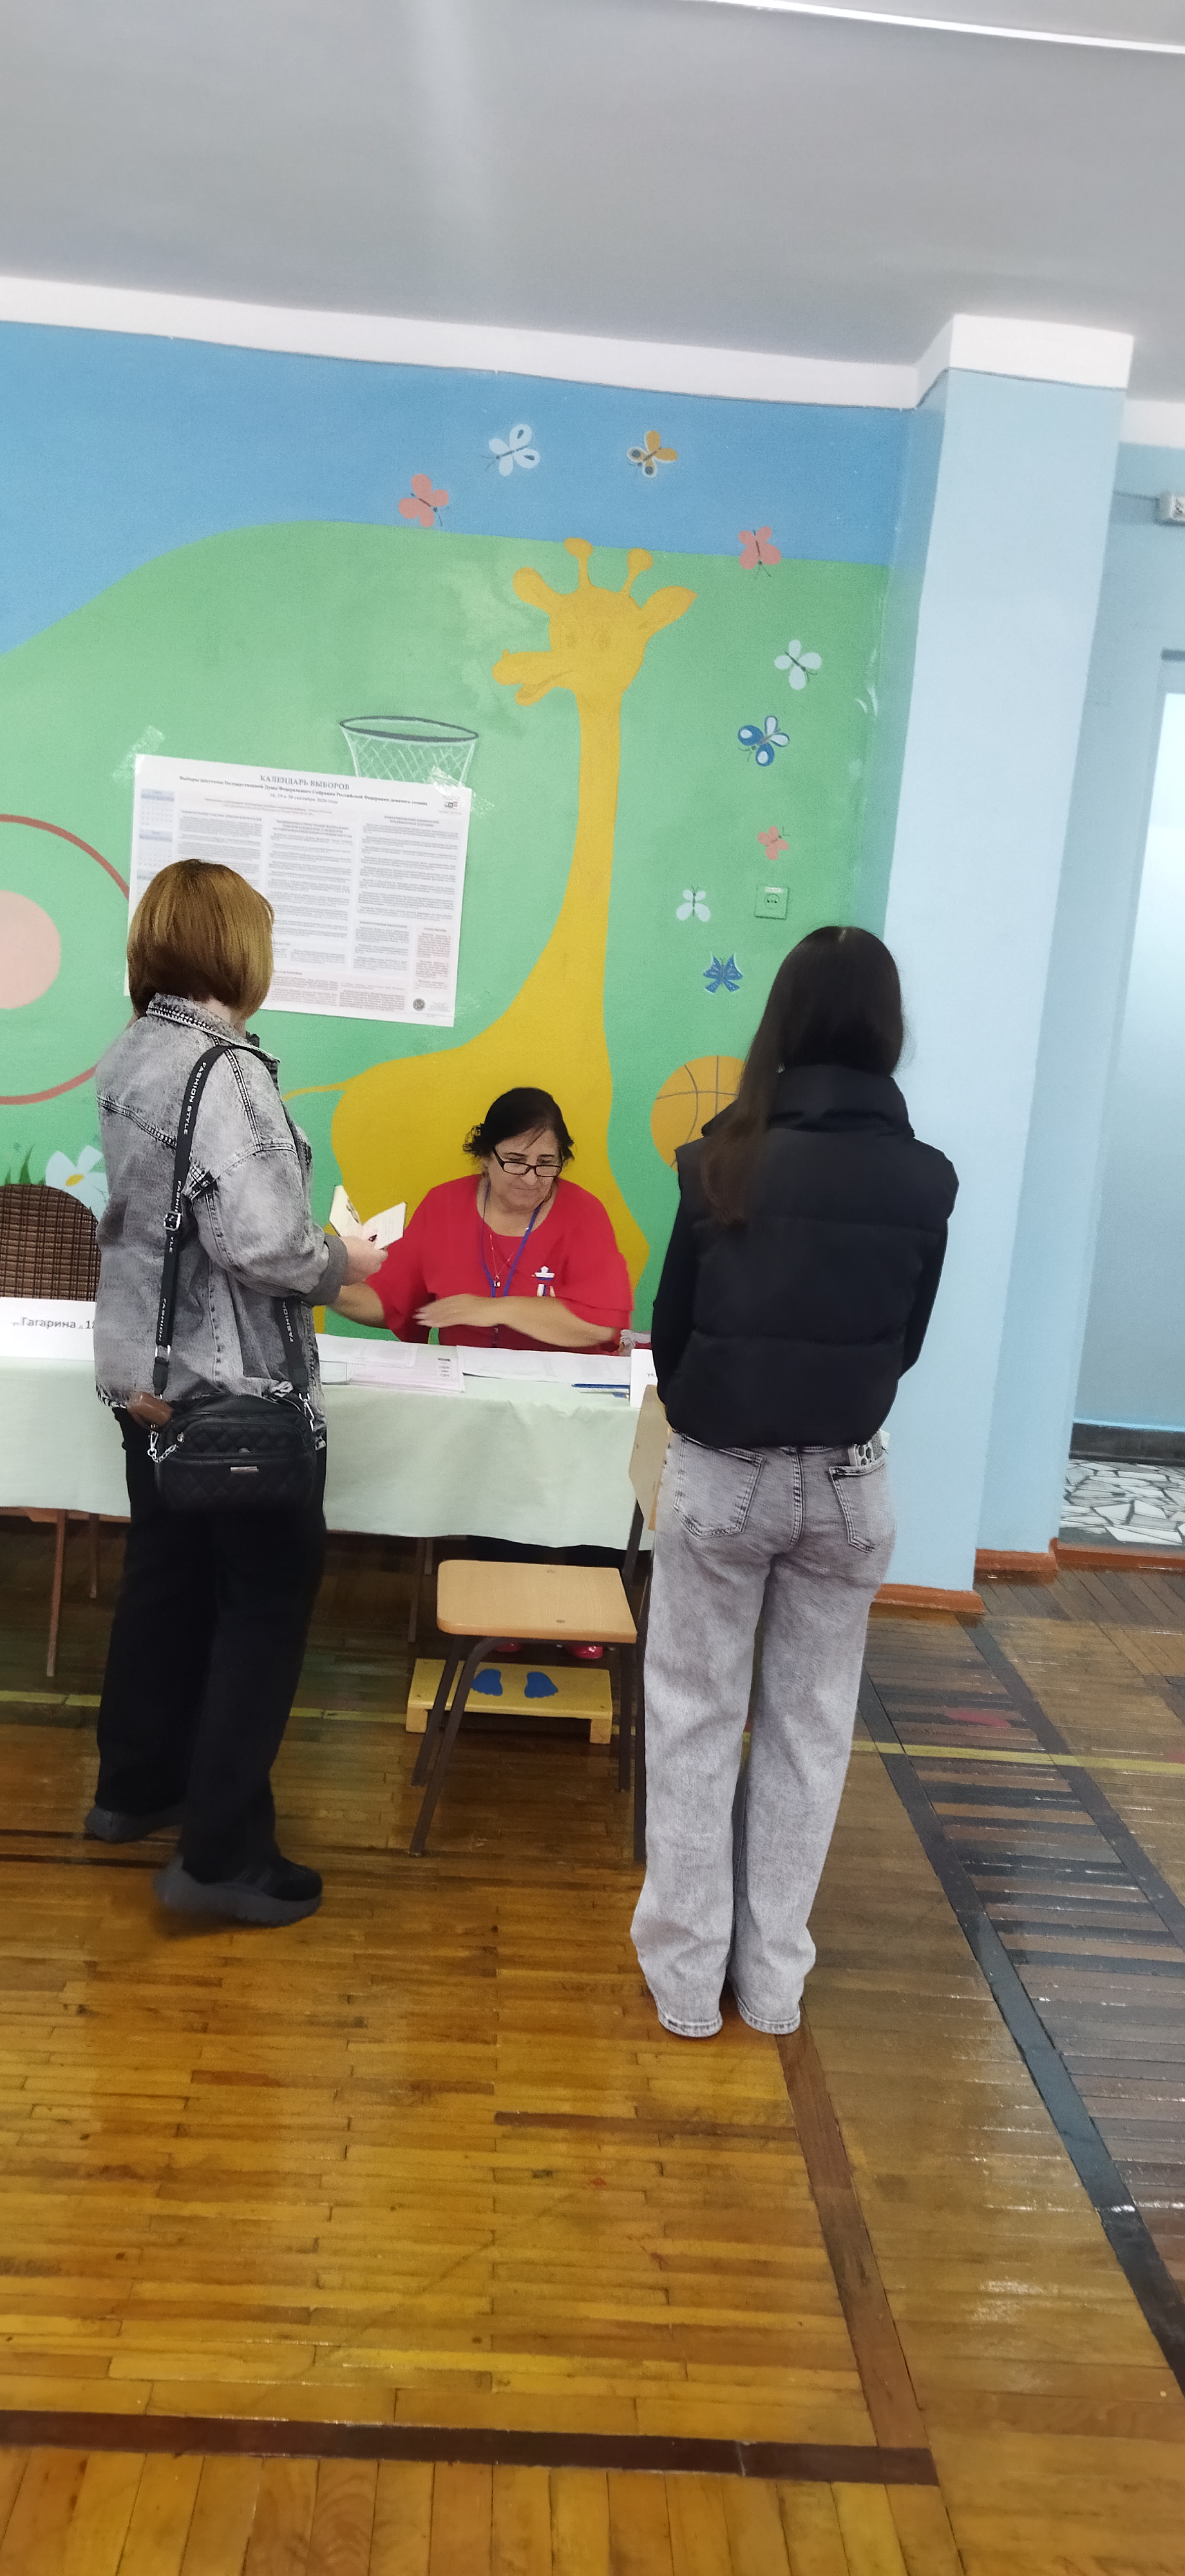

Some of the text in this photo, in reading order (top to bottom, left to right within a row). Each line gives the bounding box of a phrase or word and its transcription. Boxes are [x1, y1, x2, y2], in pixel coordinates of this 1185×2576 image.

[260, 775, 350, 790] КАЛЕНДАРЬ ВЫБОРОВ
[184, 1062, 207, 1135] FASHION STYLE
[158, 1298, 167, 1341] FASHION
[283, 1302, 294, 1342] FASHION
